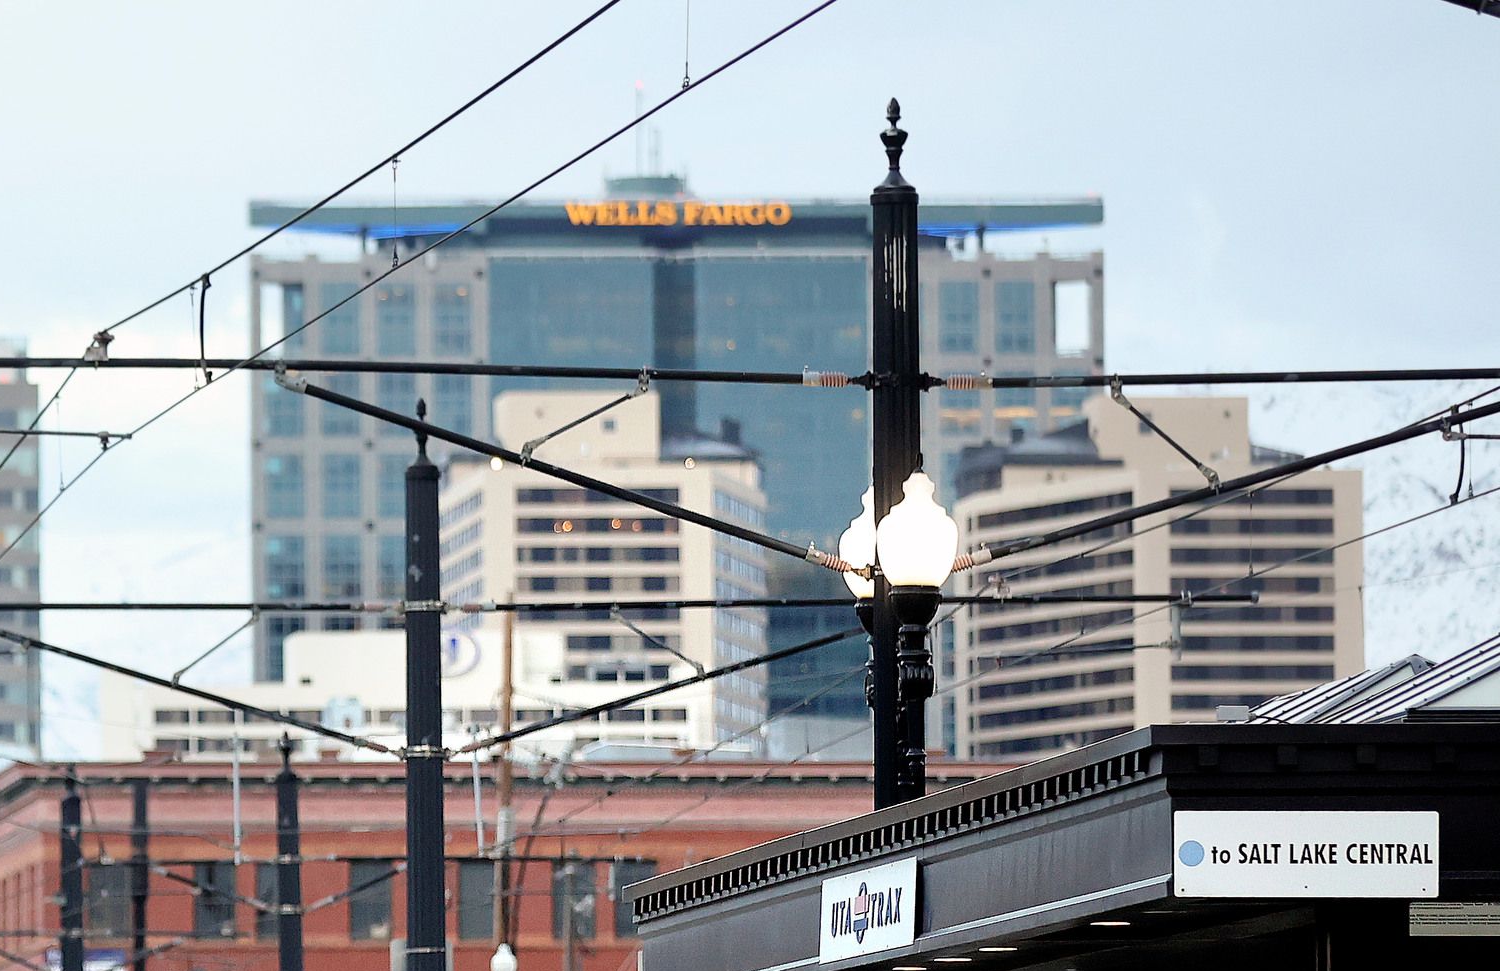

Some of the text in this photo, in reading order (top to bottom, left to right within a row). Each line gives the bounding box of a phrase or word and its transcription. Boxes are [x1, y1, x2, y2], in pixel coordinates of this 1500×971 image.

[565, 201, 793, 226] WELLS FARGO
[1211, 843, 1434, 865] to SALT LAKE CENTRAL
[831, 887, 903, 939] UTA TRAX
